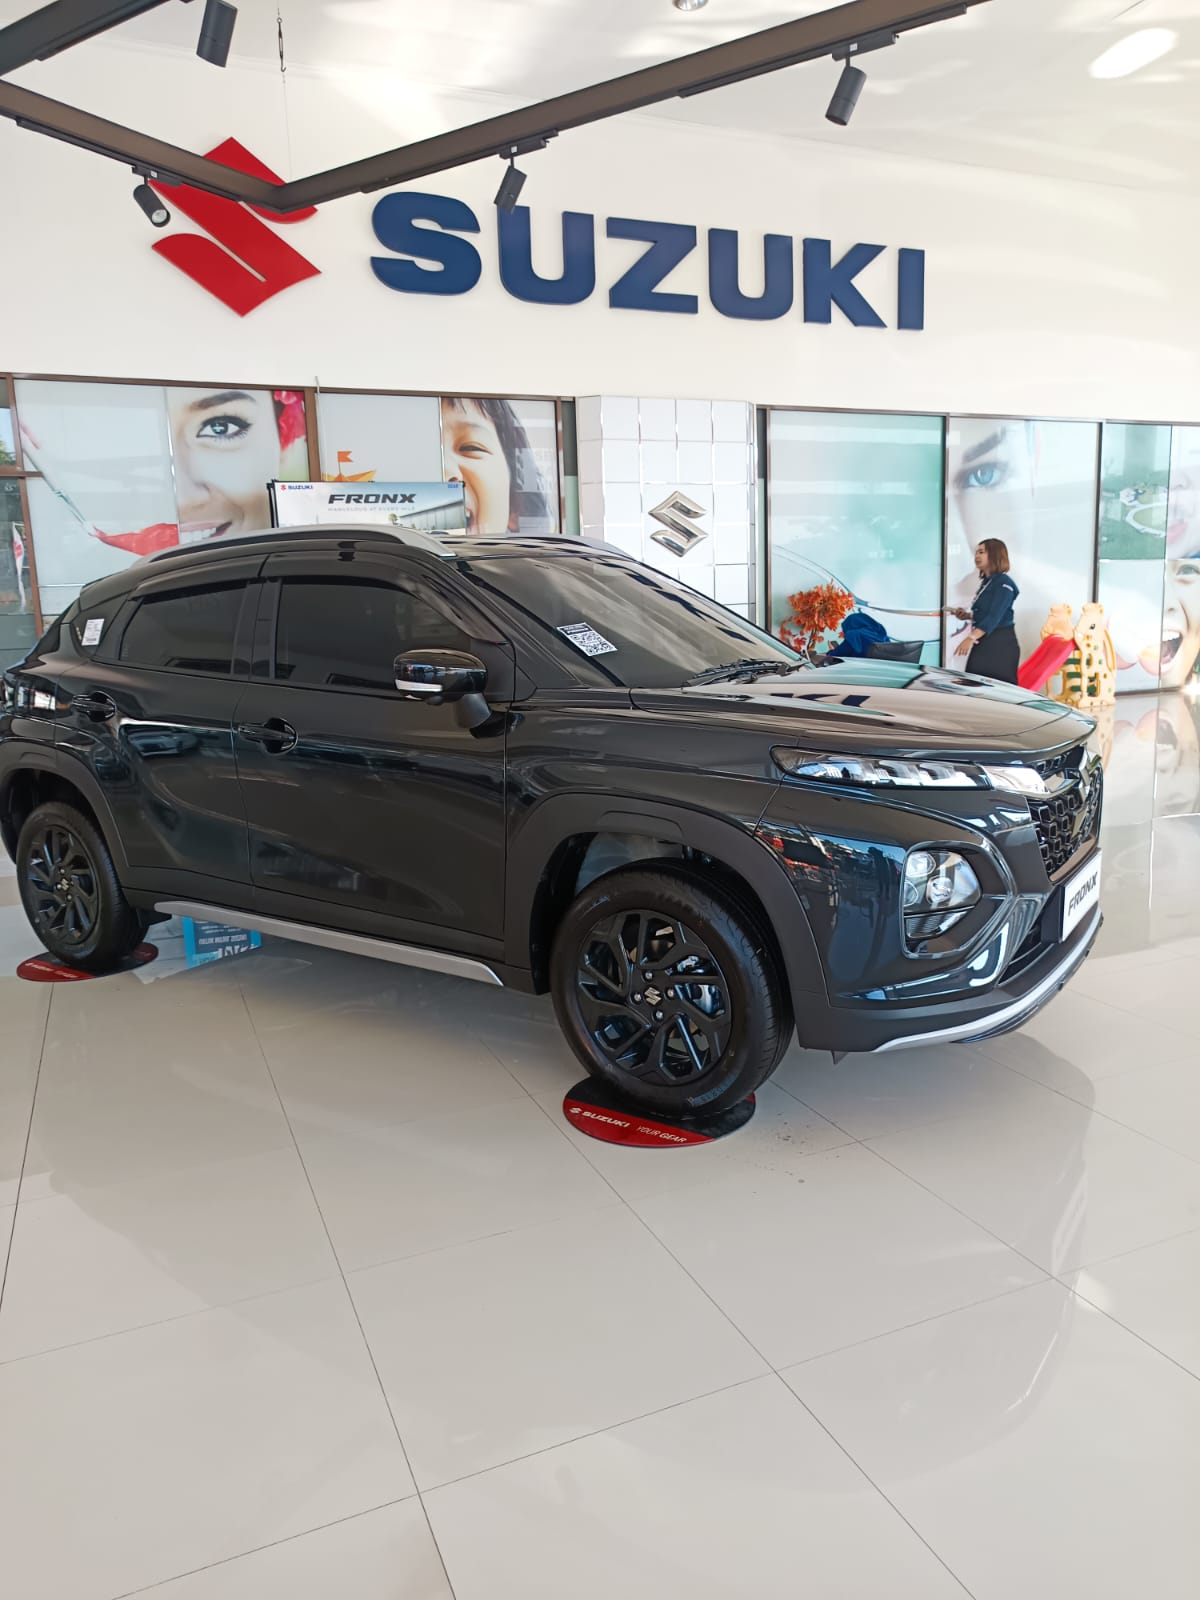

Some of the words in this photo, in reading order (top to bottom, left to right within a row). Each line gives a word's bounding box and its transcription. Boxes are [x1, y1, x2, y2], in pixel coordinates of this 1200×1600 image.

[370, 191, 925, 331] SUZUKI
[328, 493, 416, 504] FRONX
[1067, 871, 1098, 917] FRONX
[582, 1110, 631, 1128] SUZUKI
[636, 1124, 660, 1137] YOUR
[659, 1132, 687, 1144] GEAR
